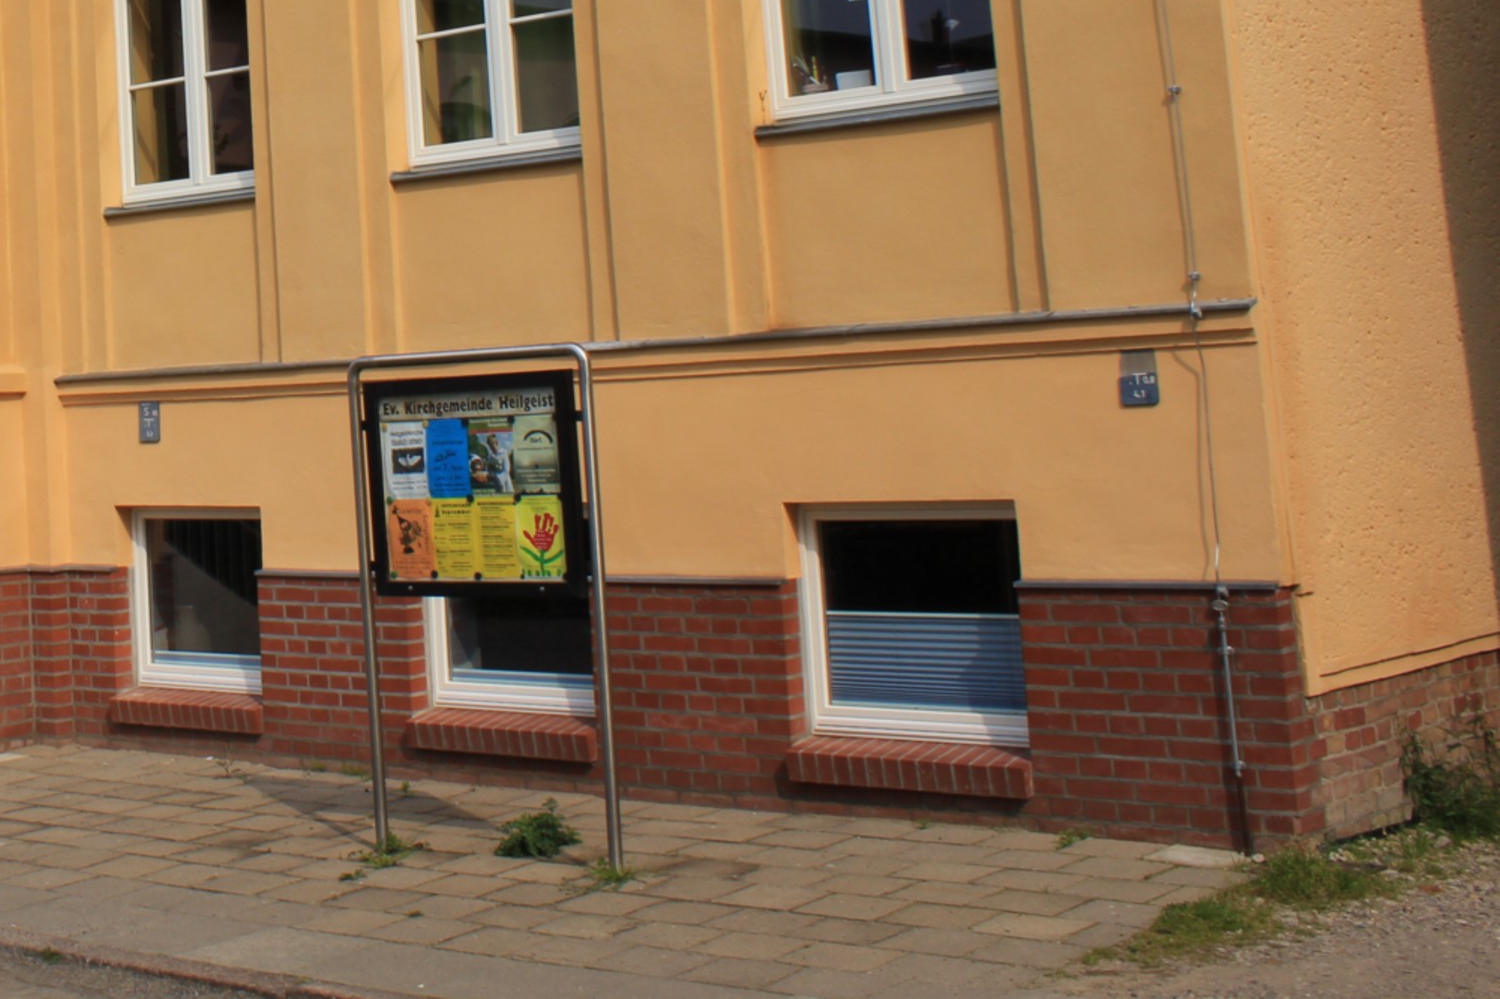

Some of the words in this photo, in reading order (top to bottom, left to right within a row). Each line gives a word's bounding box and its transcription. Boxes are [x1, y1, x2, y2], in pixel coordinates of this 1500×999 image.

[383, 402, 400, 416] Ev.
[404, 397, 493, 417] Kirchgemeinde
[498, 393, 554, 412] Heilgeist
